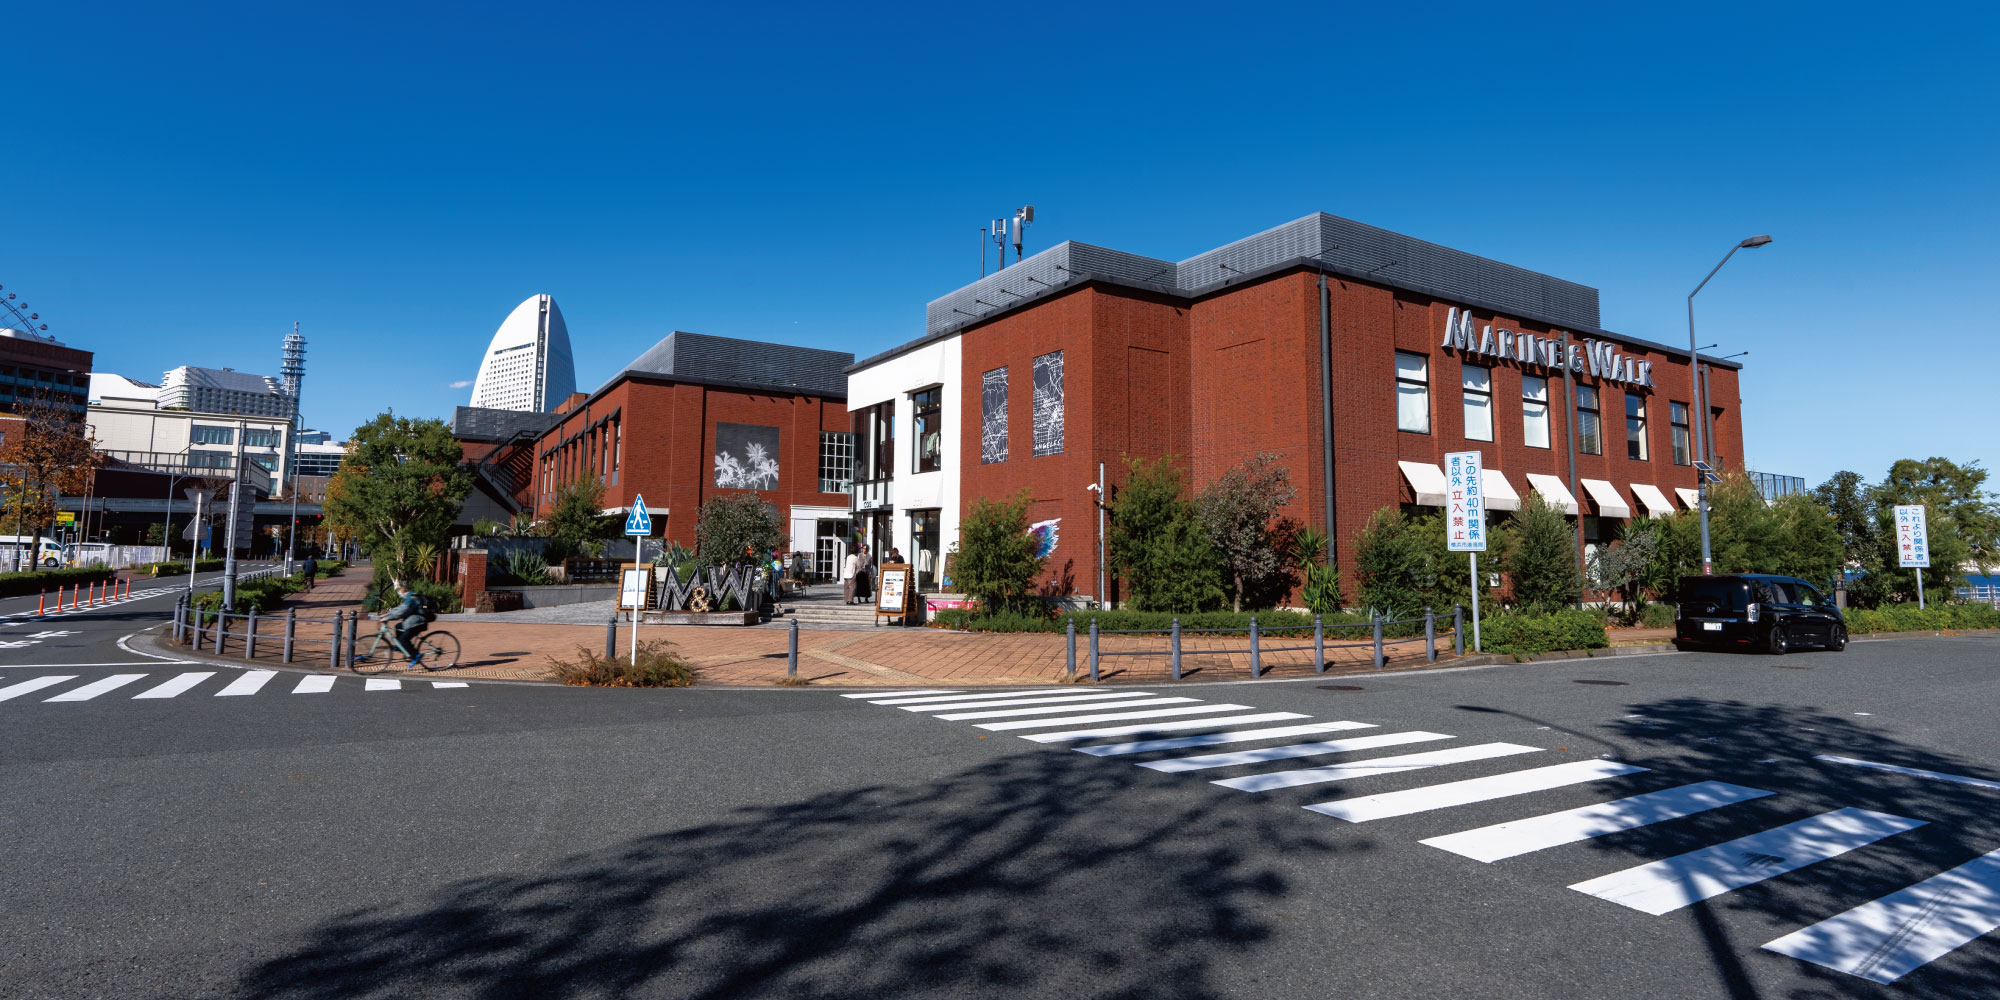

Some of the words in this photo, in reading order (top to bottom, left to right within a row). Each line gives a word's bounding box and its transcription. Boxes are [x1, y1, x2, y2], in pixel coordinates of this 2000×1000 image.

[1465, 455, 1480, 540] この先約40m関係
